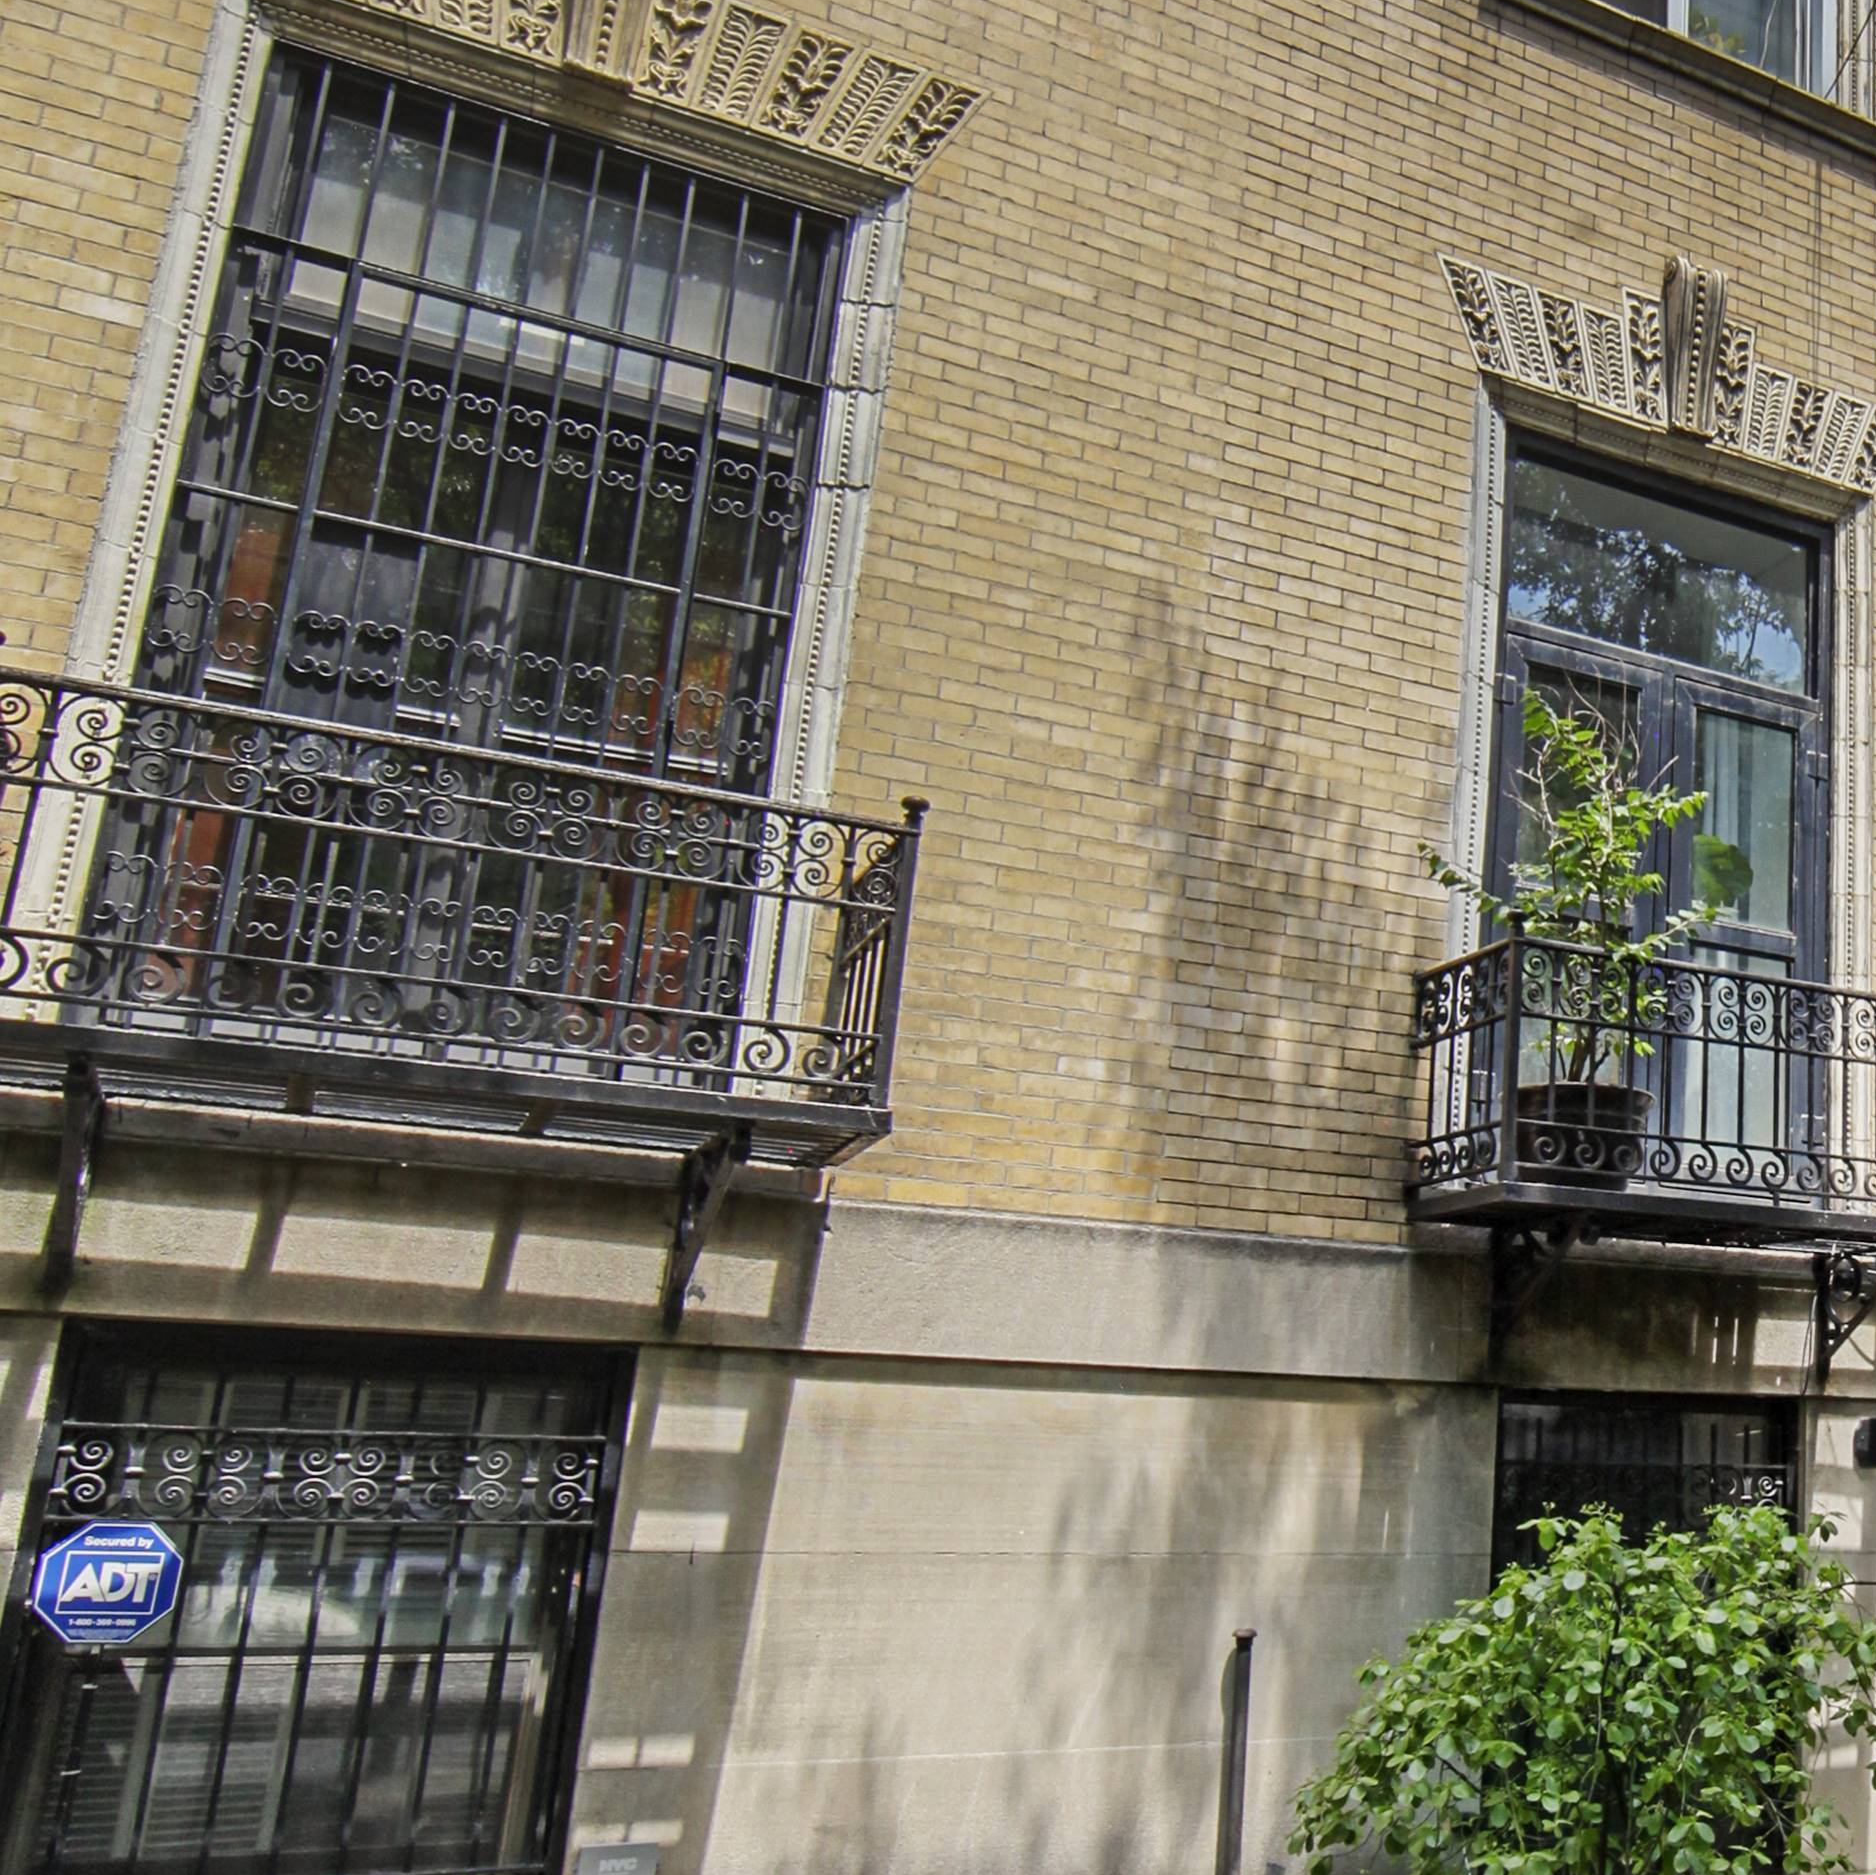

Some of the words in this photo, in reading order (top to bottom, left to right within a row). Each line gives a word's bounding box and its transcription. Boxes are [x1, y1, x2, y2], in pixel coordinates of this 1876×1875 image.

[84, 1535, 137, 1548] Secured
[137, 1536, 155, 1550] by
[59, 1561, 163, 1604] ADT
